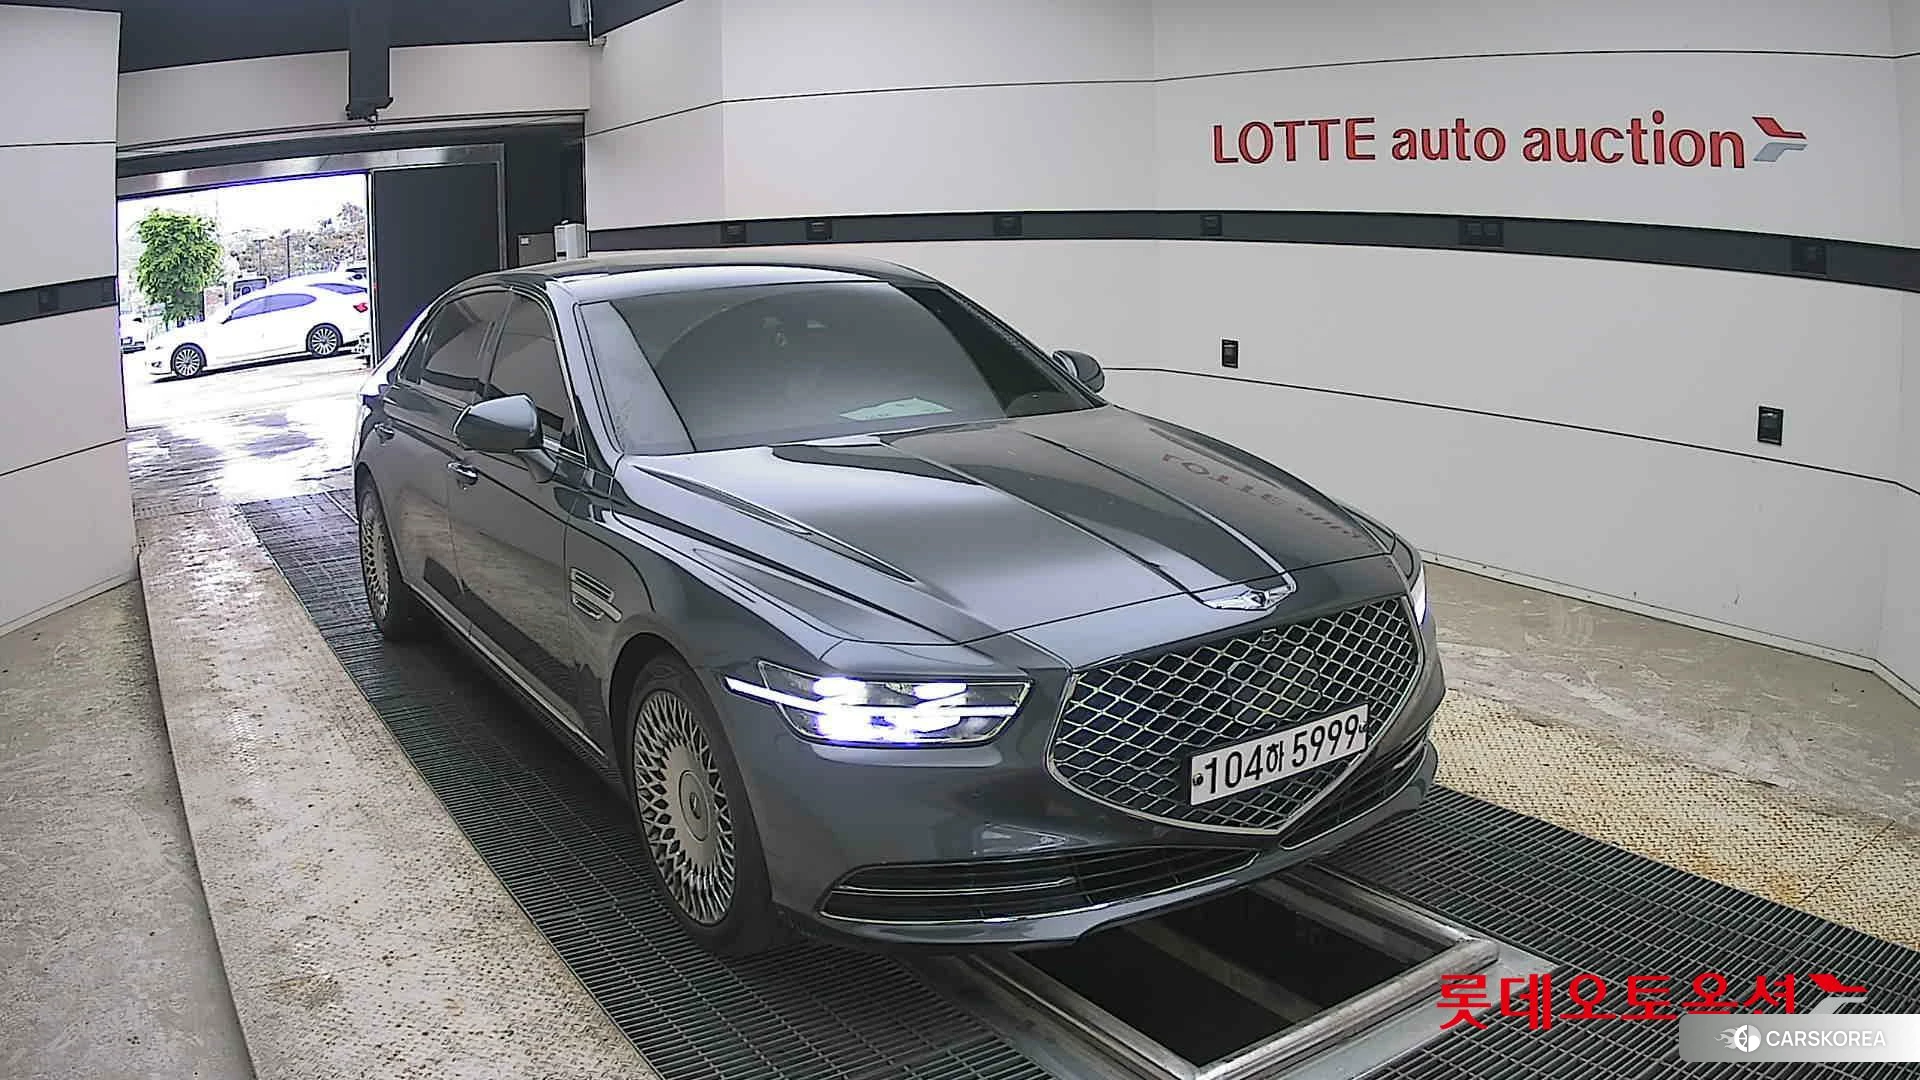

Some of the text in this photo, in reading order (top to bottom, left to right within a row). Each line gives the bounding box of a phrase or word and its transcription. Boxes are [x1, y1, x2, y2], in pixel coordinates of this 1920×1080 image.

[1212, 110, 1746, 169] LOTTE auto auction
[1205, 714, 1360, 794] 104하 5999
